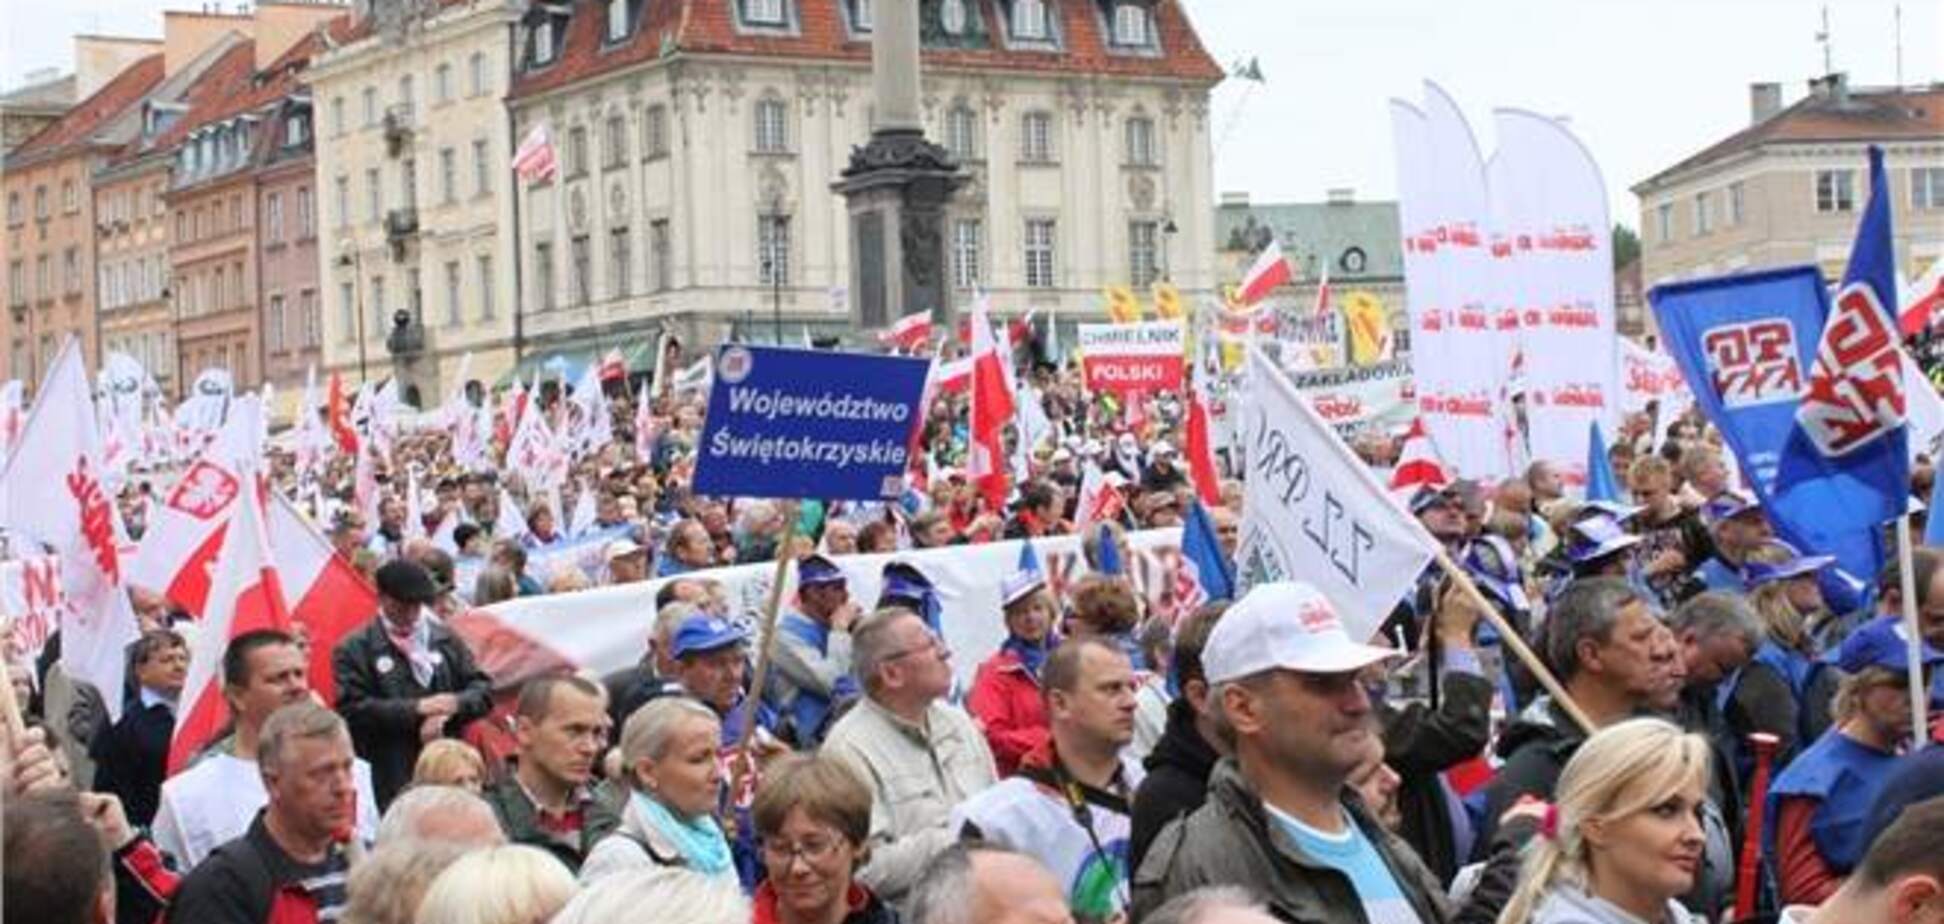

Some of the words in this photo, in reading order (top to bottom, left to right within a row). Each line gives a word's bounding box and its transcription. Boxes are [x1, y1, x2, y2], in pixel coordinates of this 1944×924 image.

[1083, 327, 1179, 345] CHMIELNIK
[1091, 363, 1163, 381] POLSKI
[729, 387, 909, 422] Województwo
[709, 425, 907, 469] Świętokrzyskie
